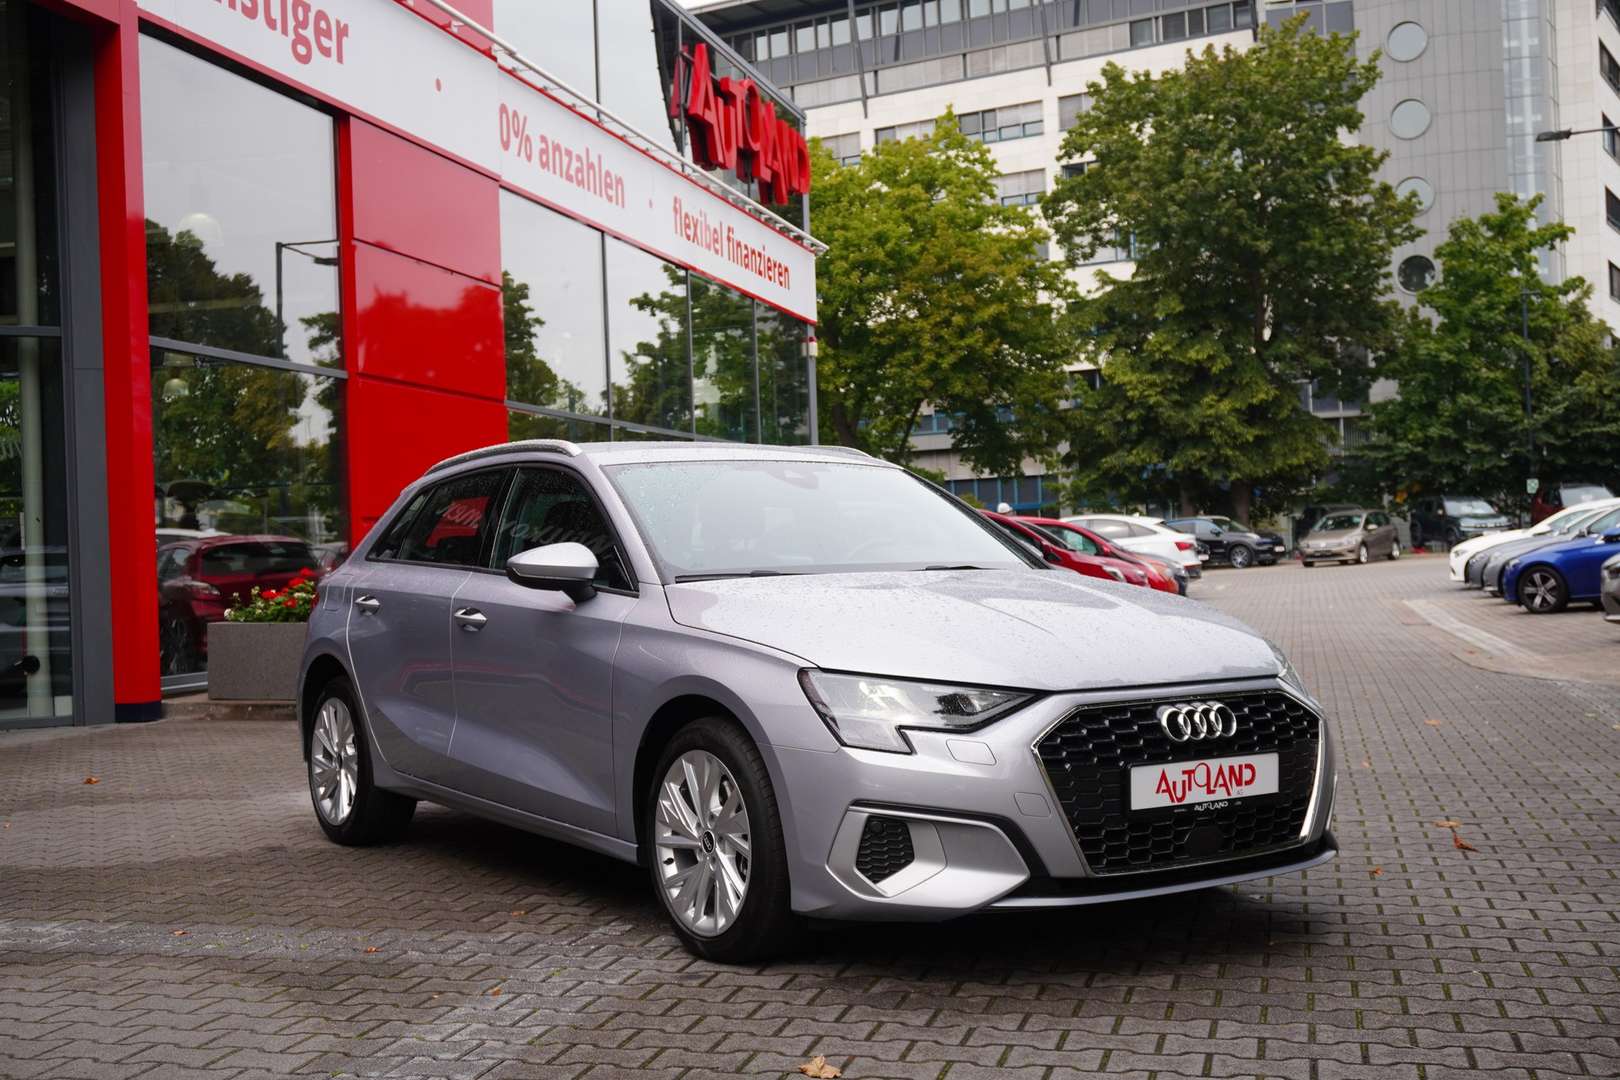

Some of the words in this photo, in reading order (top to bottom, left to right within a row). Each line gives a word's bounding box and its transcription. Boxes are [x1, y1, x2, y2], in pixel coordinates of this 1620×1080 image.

[210, 0, 349, 65] tiger
[499, 103, 533, 162] 0%
[538, 134, 625, 208] anzahlen
[673, 196, 724, 257] flexibel
[726, 225, 790, 289] finanzieren
[1155, 762, 1256, 803] AUTOLAND
[1194, 801, 1229, 812] AUTOLAND
